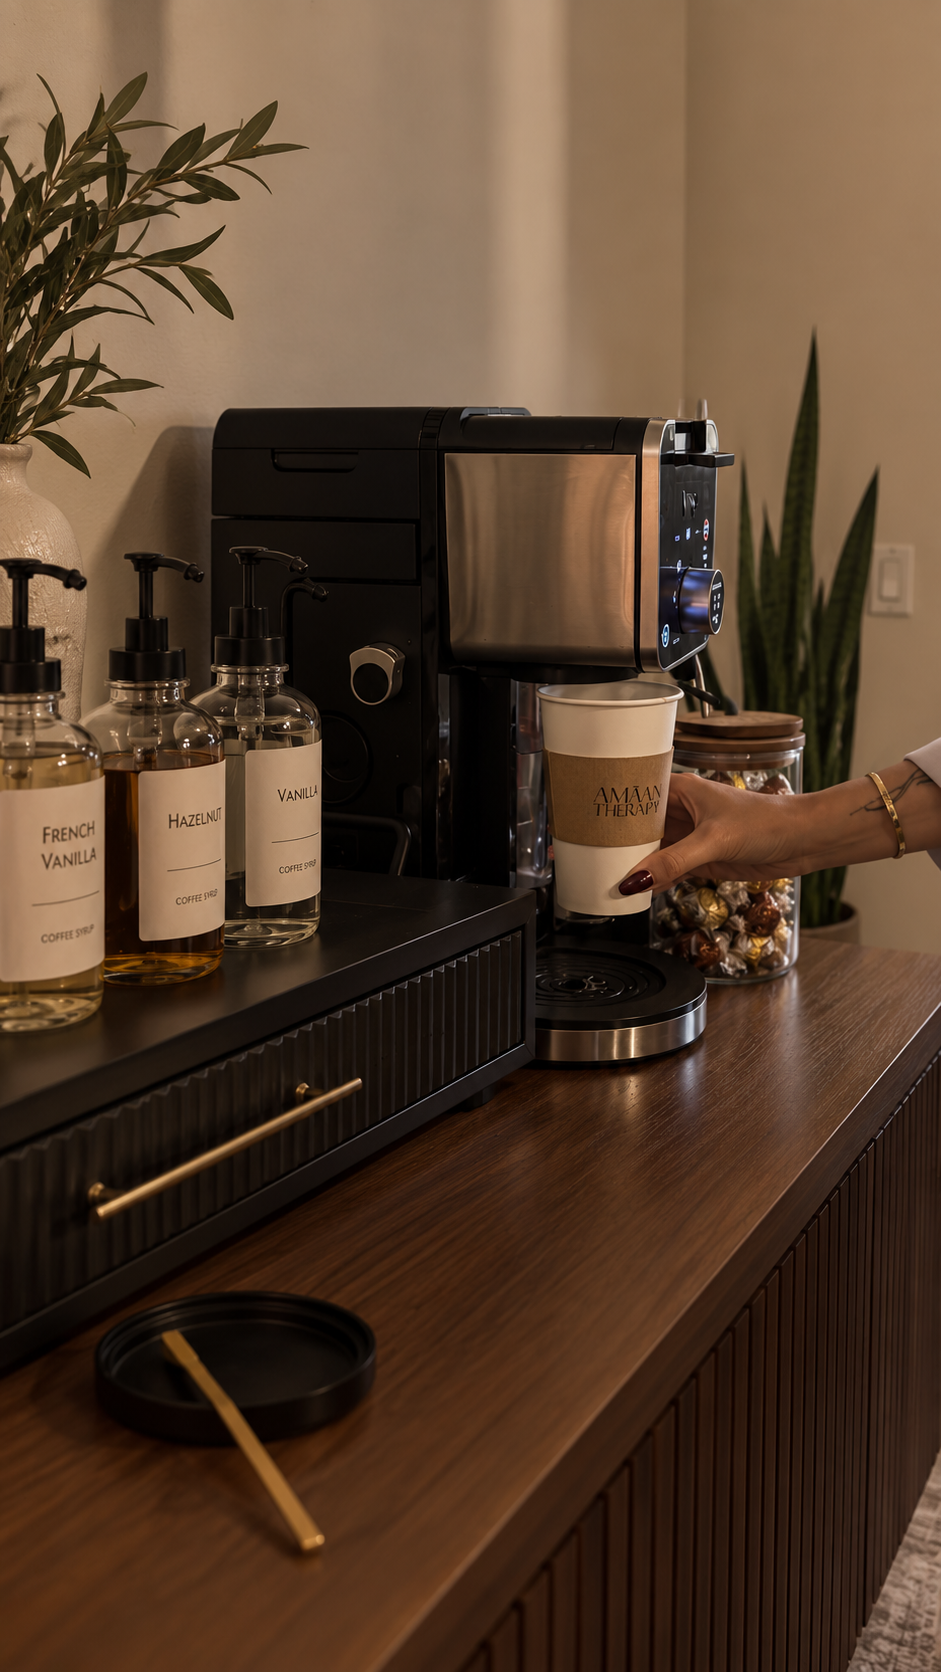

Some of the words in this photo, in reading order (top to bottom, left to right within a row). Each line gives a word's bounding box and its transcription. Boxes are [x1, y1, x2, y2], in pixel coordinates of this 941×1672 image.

[277, 784, 318, 802] VANILLA
[593, 800, 660, 817] THERAPY
[168, 807, 222, 829] HAZELNUT
[42, 820, 95, 844] FRENCH
[41, 847, 97, 870] VANILLA
[279, 863, 303, 874] COFFEE
[175, 893, 203, 906] COFFEE
[41, 929, 75, 944] COFFEE
